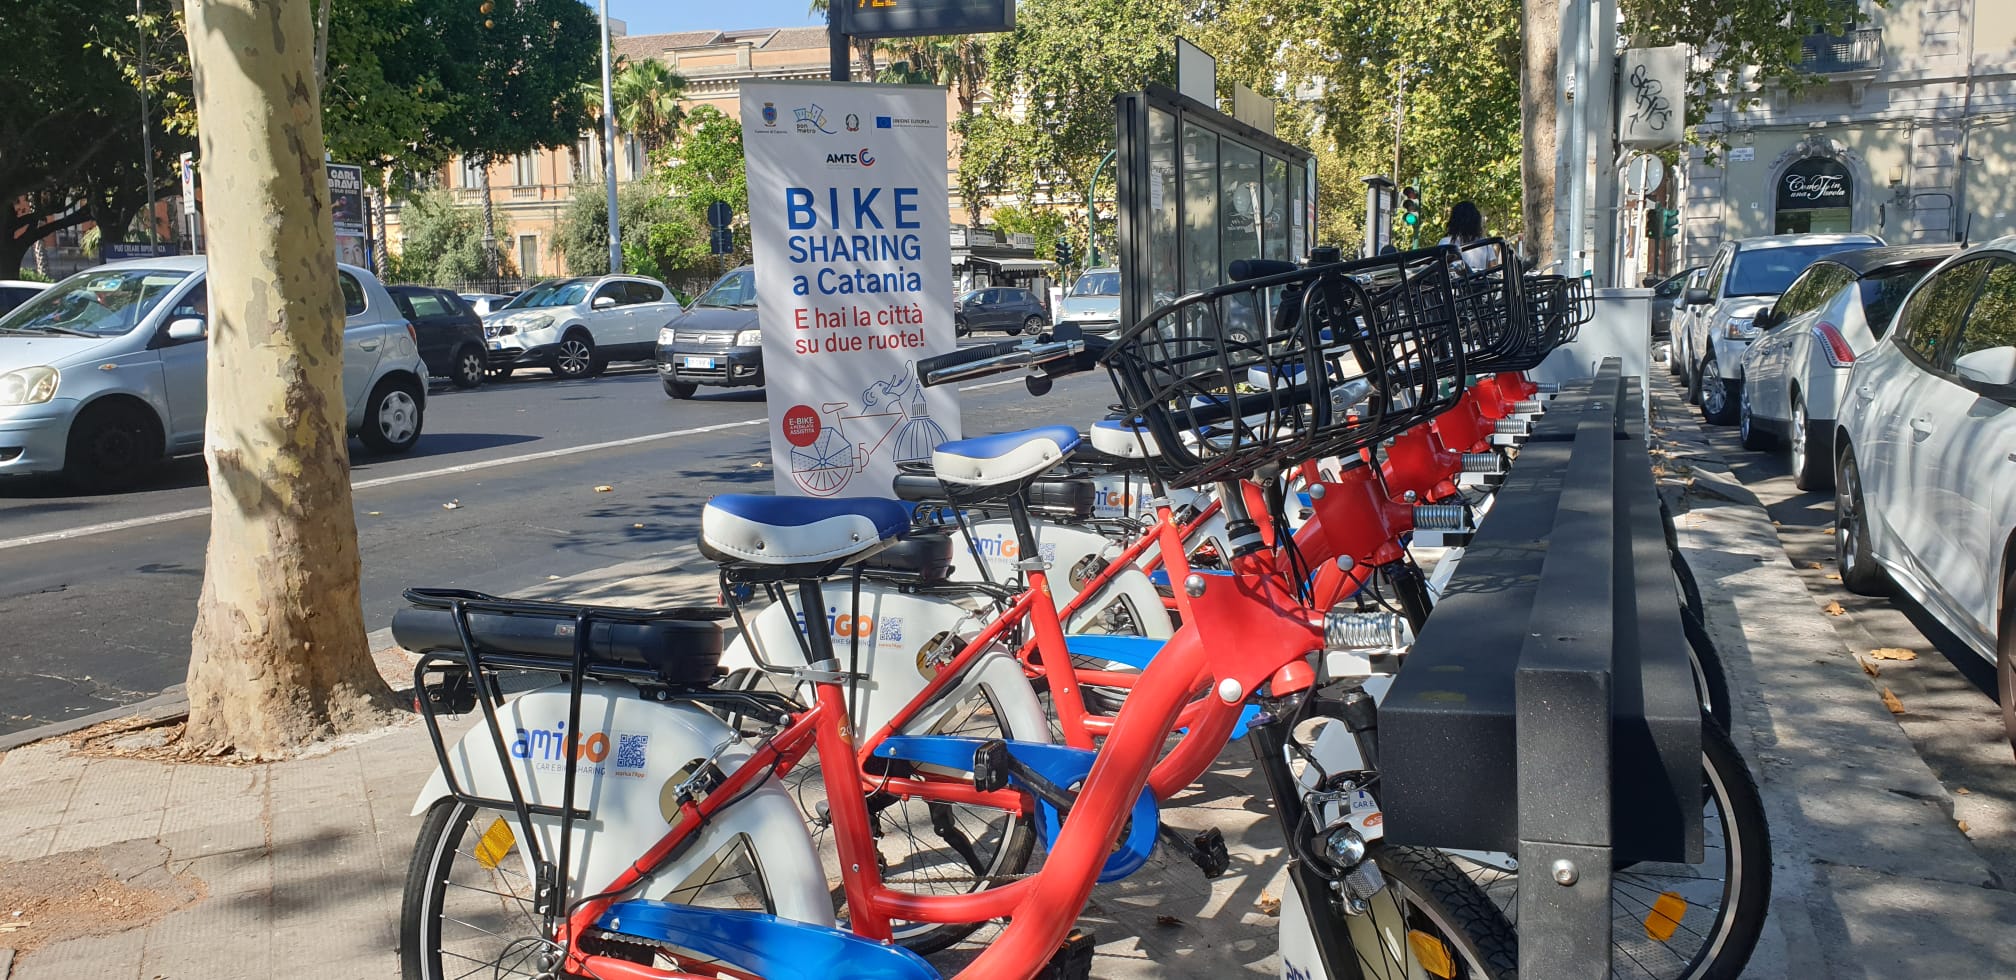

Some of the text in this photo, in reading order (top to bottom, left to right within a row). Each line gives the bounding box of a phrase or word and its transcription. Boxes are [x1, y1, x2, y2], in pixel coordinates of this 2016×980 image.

[826, 153, 858, 164] AMTS
[327, 178, 360, 190] BRAVE
[330, 169, 356, 180] CARL
[785, 187, 921, 230] BIKE
[788, 234, 921, 264] SHARING
[792, 266, 922, 296] a Catania
[794, 302, 923, 329] E hai la città
[795, 328, 925, 355] su due ruote!
[789, 416, 814, 426] E-BIKE
[536, 762, 550, 770] CAR
[576, 766, 606, 776] HARING
